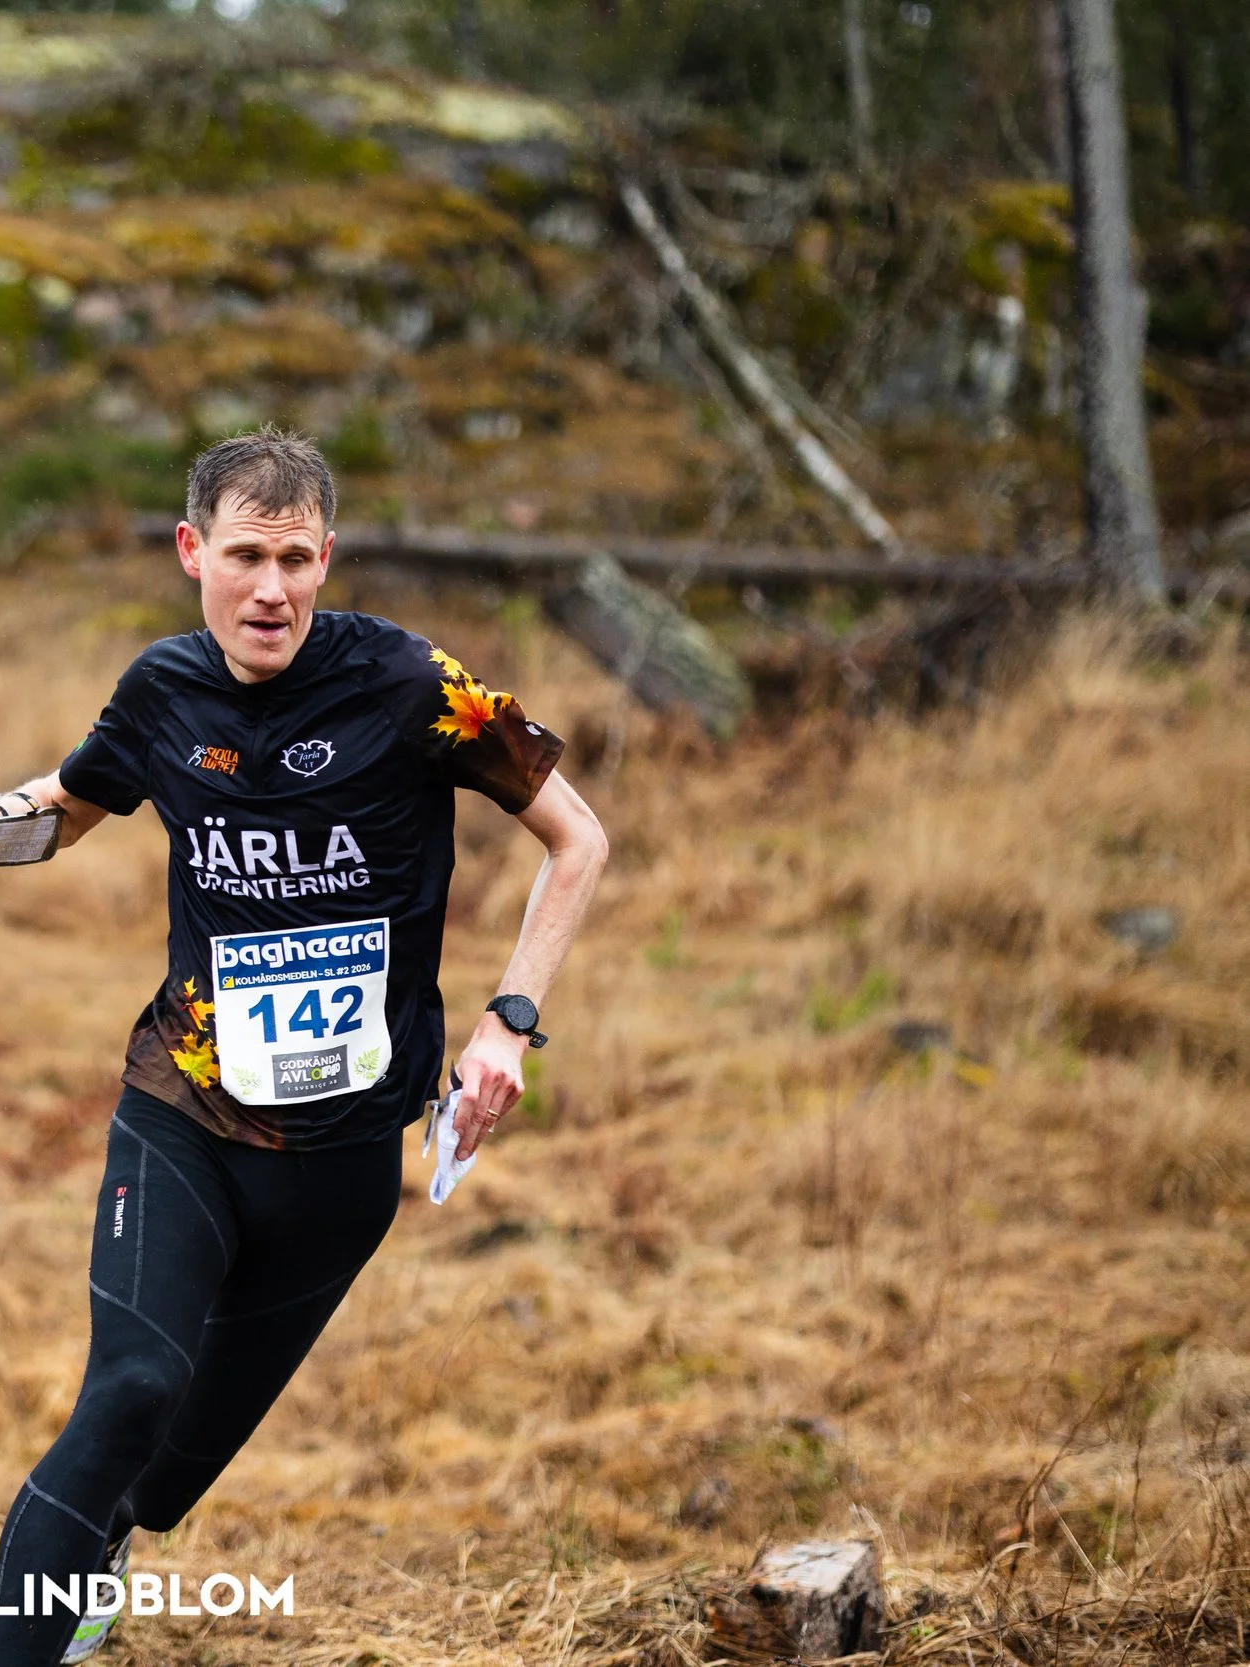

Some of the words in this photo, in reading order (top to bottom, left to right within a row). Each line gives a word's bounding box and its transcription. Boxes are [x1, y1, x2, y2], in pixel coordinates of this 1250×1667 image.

[186, 816, 366, 876] JÄRLA
[217, 930, 384, 968] bagheera
[235, 970, 318, 986] KOLMÅRDSMEDELN
[324, 968, 335, 977] SL
[336, 966, 350, 975] #2
[351, 963, 372, 974] 2026
[248, 985, 364, 1043] 142
[279, 1053, 342, 1070] GODKÄNDA
[280, 1063, 341, 1084] AVLOPP
[114, 1198, 125, 1238] TRIMTEX
